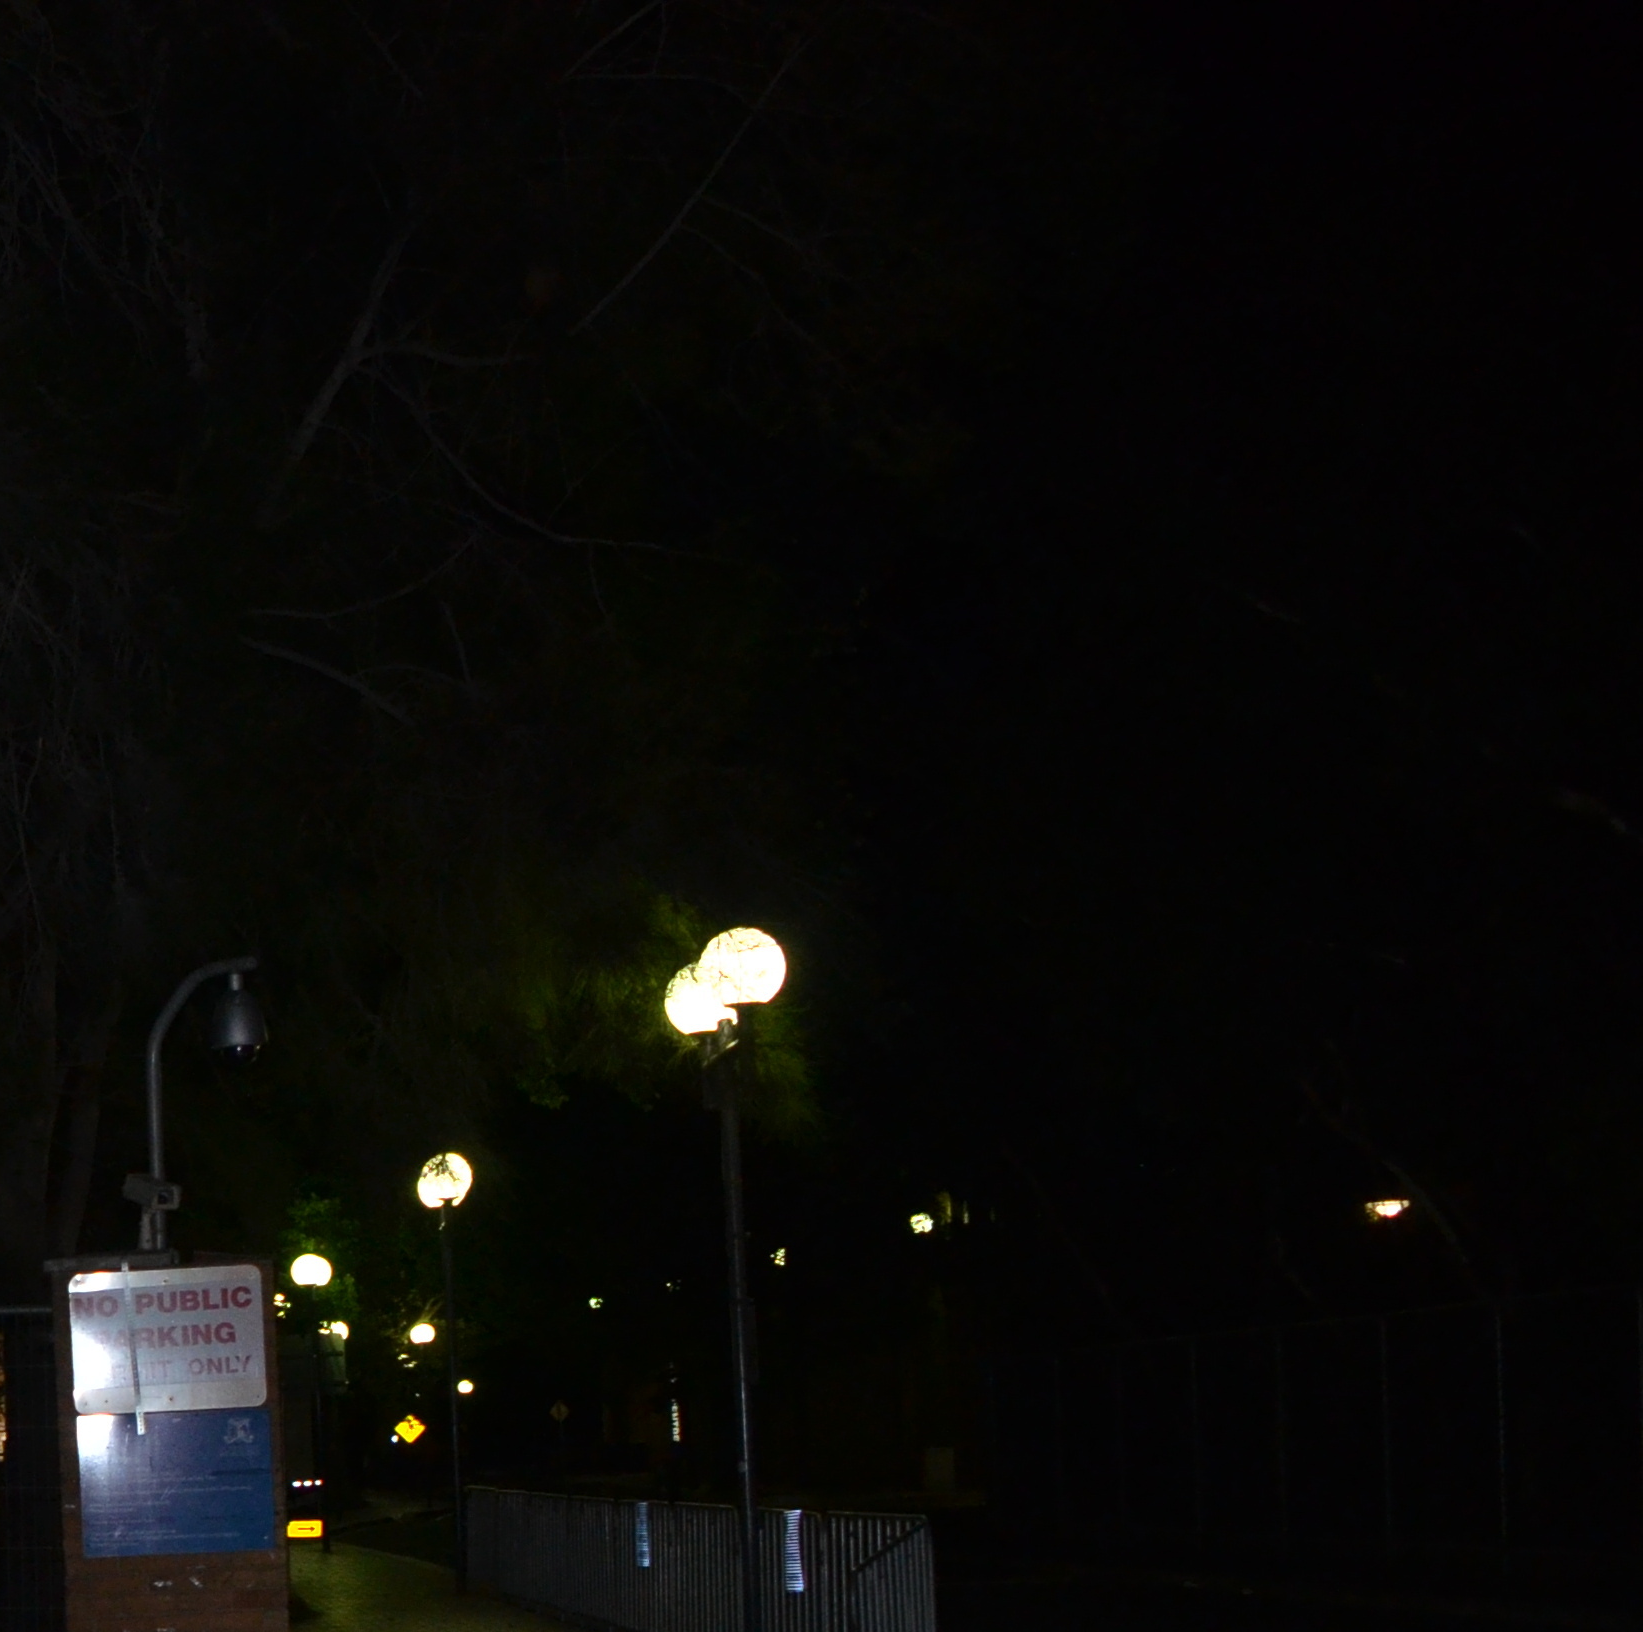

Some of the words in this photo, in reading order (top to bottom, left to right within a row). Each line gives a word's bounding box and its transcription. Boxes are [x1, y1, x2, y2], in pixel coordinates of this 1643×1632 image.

[72, 1295, 119, 1319] NO
[135, 1286, 253, 1315] PUBLIC
[189, 1355, 253, 1376] ONLY
